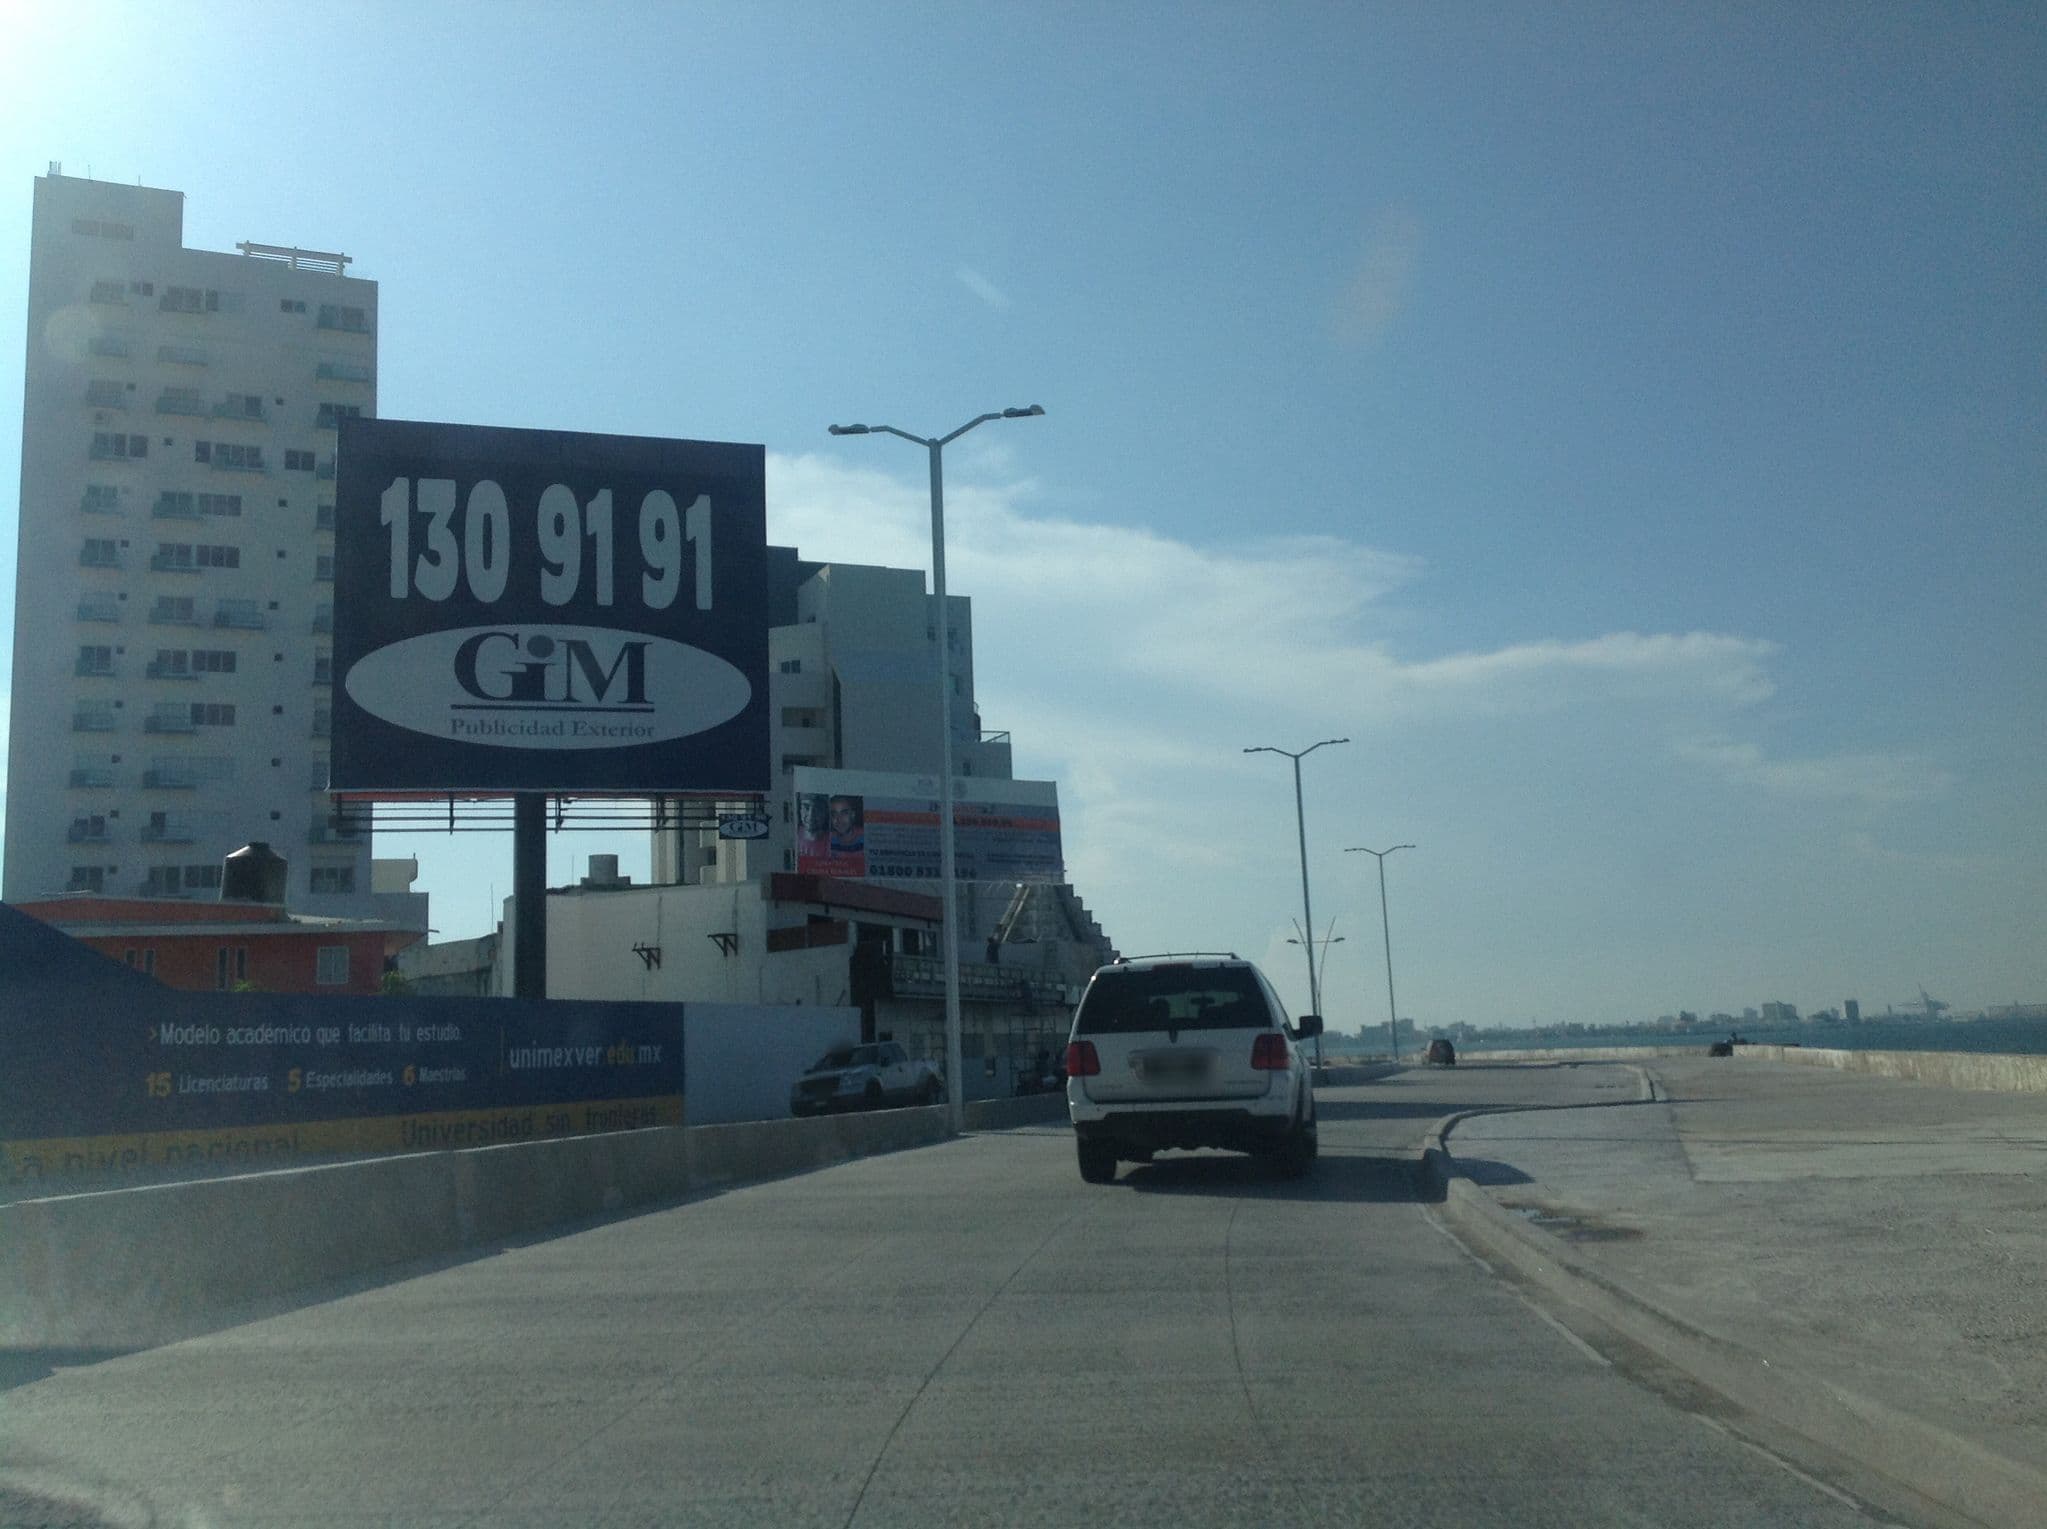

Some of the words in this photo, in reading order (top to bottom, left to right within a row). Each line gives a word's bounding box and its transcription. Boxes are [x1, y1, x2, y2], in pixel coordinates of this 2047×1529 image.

[380, 477, 511, 604] 130
[537, 483, 615, 607] 91
[638, 489, 714, 610] 91
[450, 718, 565, 738] Publicidad
[570, 719, 656, 739] Exterior
[160, 1023, 221, 1045] Modelo
[316, 1027, 341, 1048] que
[349, 1023, 391, 1043] facilita
[400, 1023, 411, 1042] tu
[146, 1072, 172, 1098] 15
[178, 1073, 271, 1094] Licenciaturas
[288, 1068, 304, 1094] 5
[306, 1068, 399, 1091] Especialidades
[402, 1064, 416, 1088] 6
[401, 1110, 533, 1146] Universidad
[545, 1112, 570, 1132] sin
